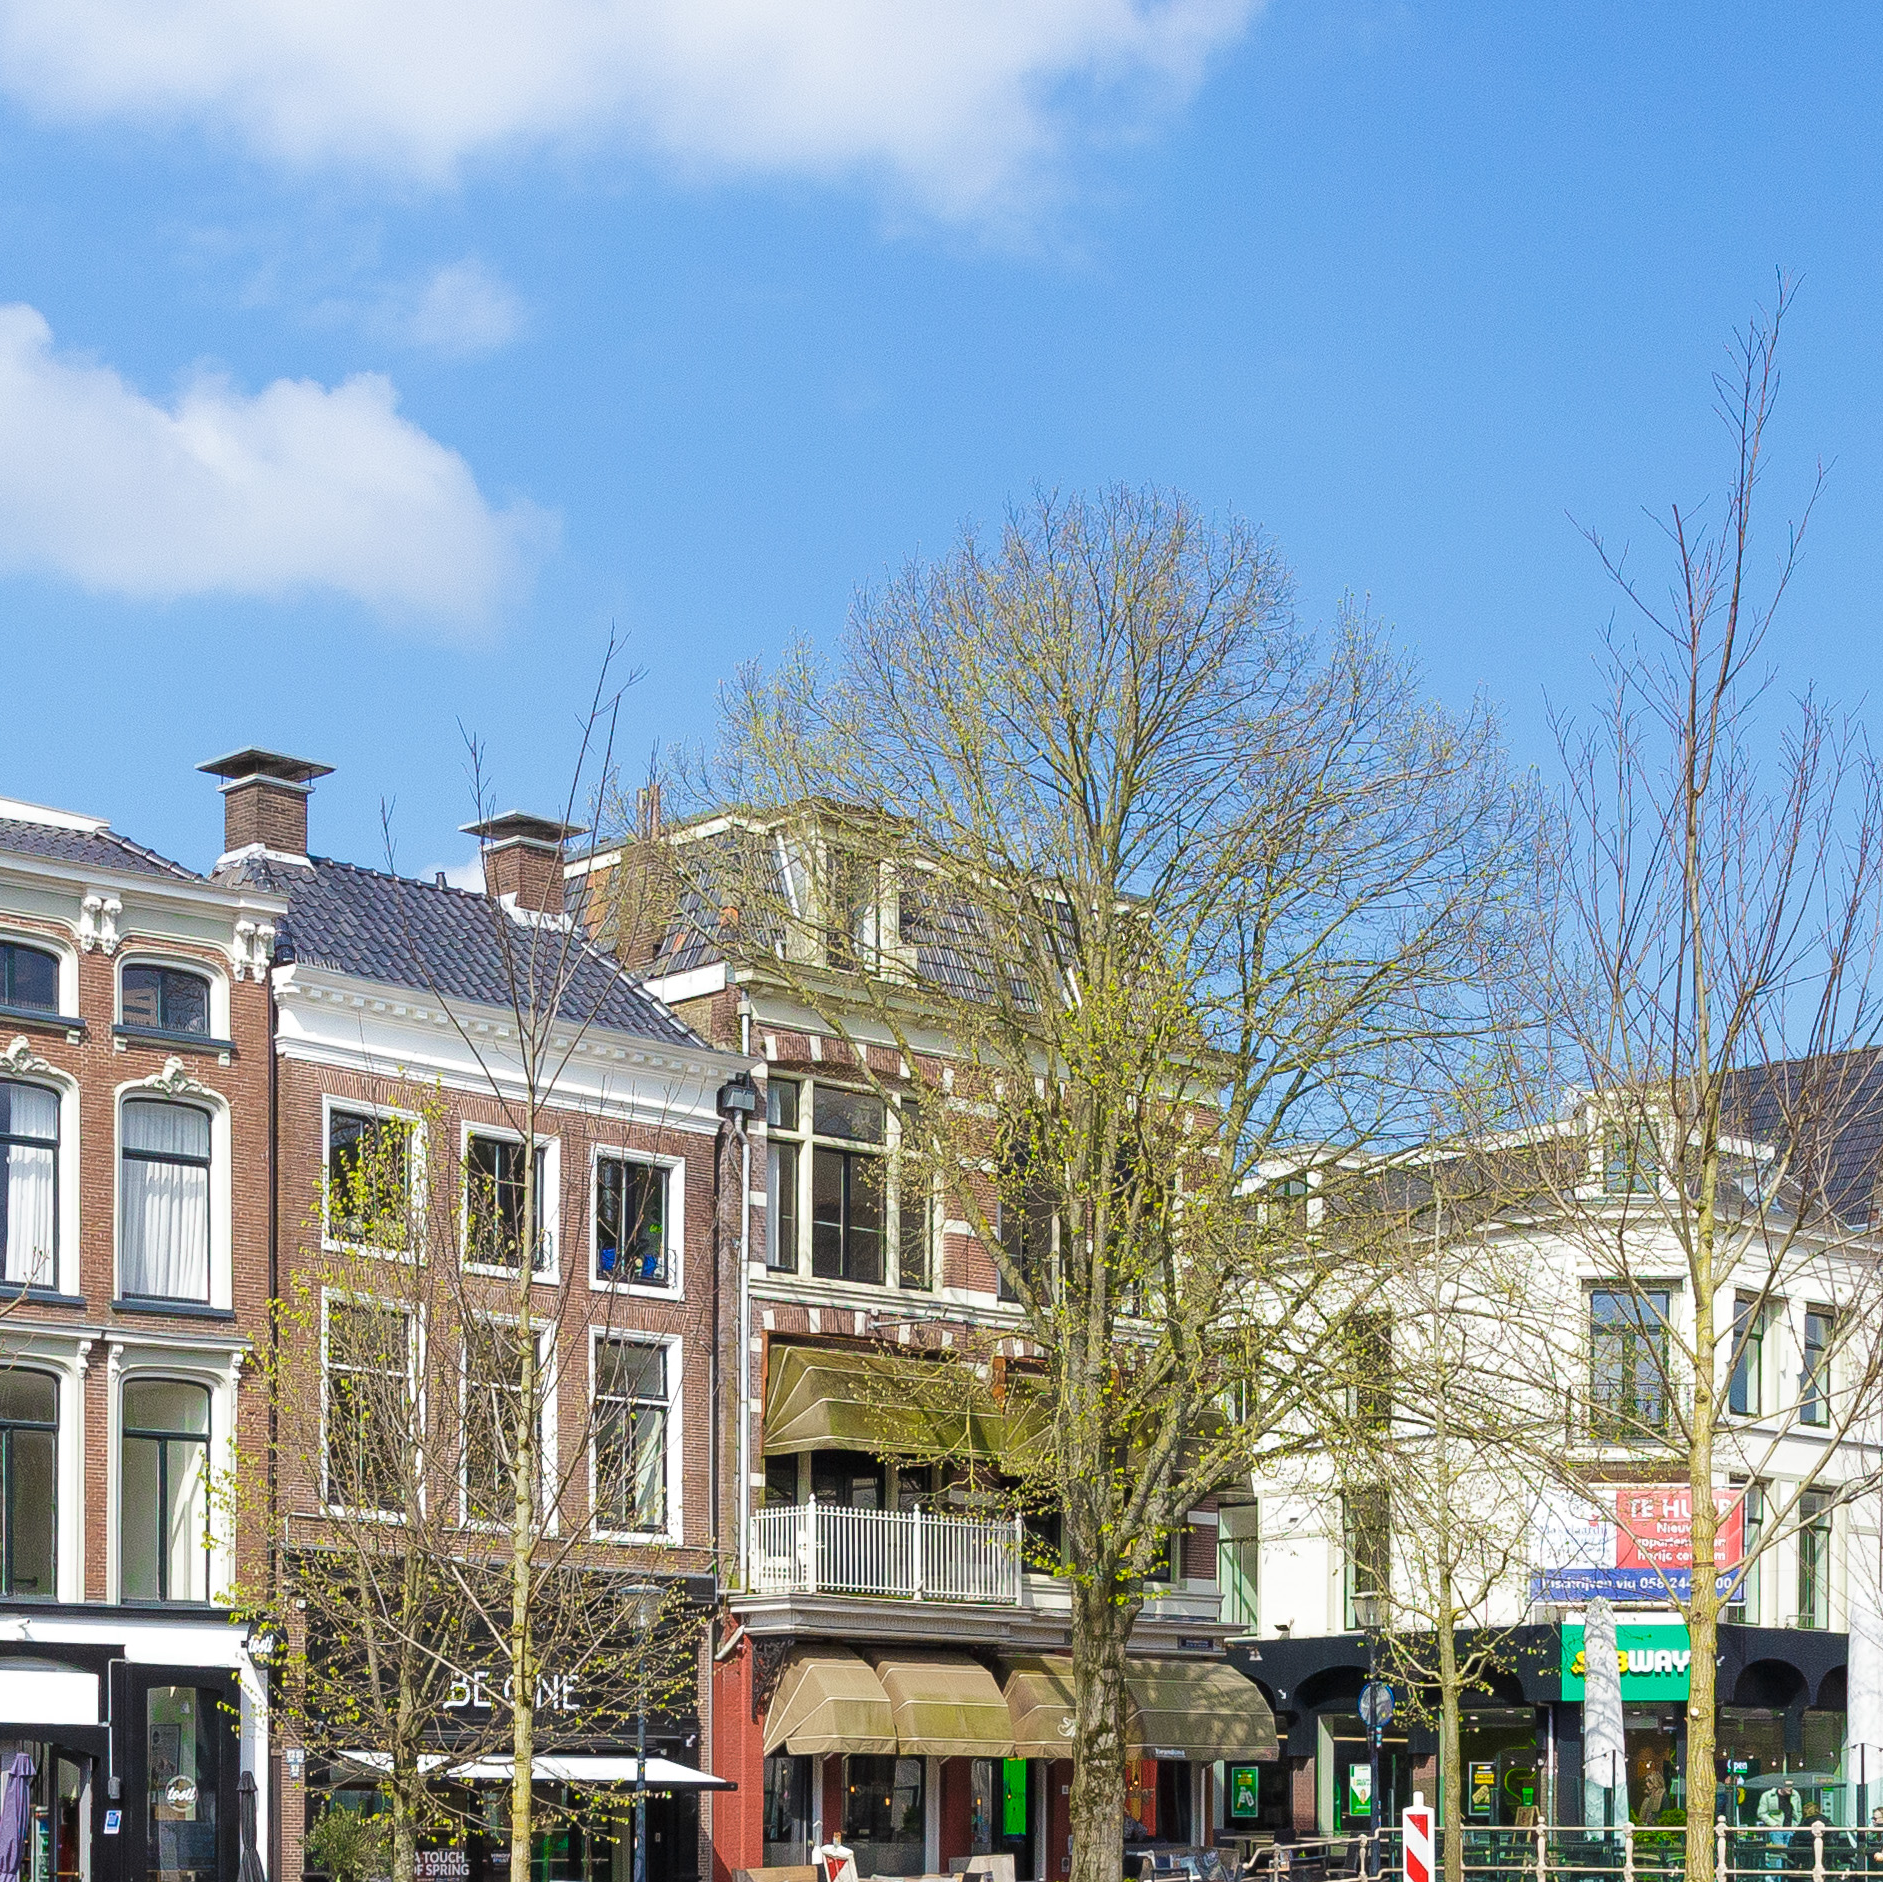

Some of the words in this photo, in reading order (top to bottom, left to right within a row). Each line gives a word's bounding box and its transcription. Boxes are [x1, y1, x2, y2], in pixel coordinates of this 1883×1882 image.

[1631, 1499, 1654, 1518] TE
[1663, 1499, 1733, 1518] HUR
[1618, 1577, 1635, 1589] via
[1571, 1650, 1691, 1673] SBWAY
[443, 1671, 491, 1708] BE
[423, 1851, 465, 1863] TOUCH
[426, 1864, 470, 1876] SPRING
